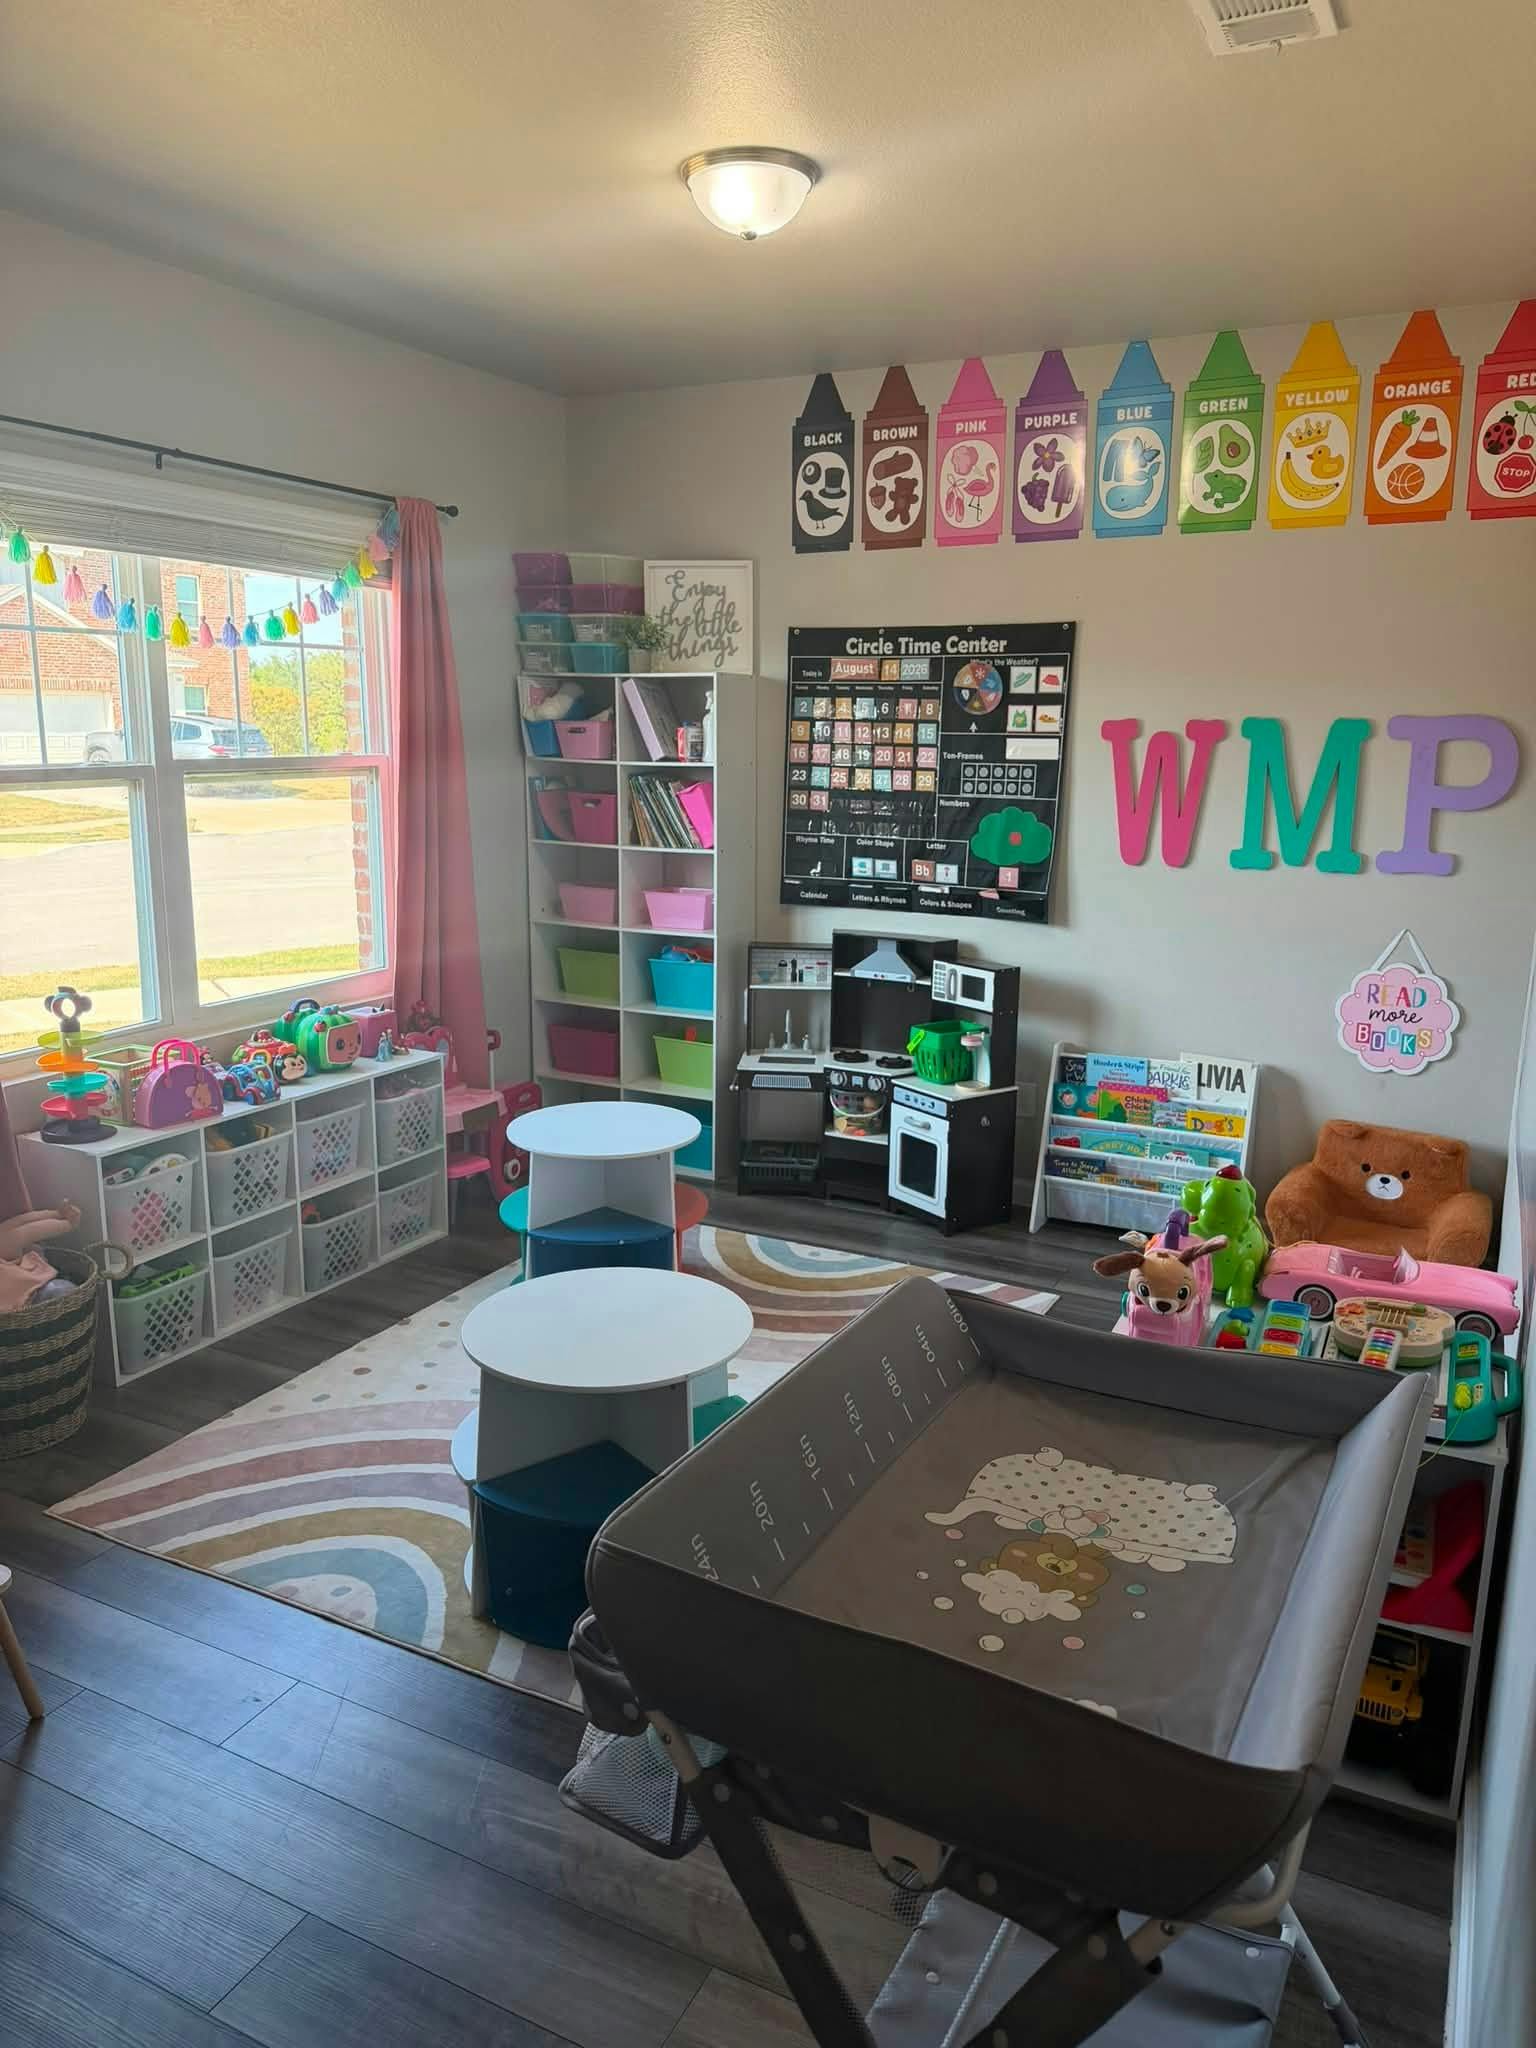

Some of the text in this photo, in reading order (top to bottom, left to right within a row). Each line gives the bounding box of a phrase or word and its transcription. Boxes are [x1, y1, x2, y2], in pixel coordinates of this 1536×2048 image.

[1285, 388, 1350, 407] YELLOW
[1383, 380, 1452, 399] ORANGE
[1116, 405, 1153, 422] BLUE
[1199, 397, 1249, 414] GREEN
[955, 419, 987, 434] PINK
[1024, 412, 1078, 430] PURPLE
[803, 432, 843, 447] BLACK
[872, 426, 918, 441] BROWN
[1502, 467, 1531, 477] STOP
[665, 570, 726, 612] Enjoy
[656, 602, 742, 638] the little
[668, 628, 738, 668] things
[845, 635, 1007, 655] Circle Time Center
[835, 662, 874, 676] August
[885, 663, 897, 676] 14
[902, 662, 929, 675] 2026
[799, 702, 808, 713] 2
[817, 702, 826, 713] 3
[839, 702, 848, 713] 4
[861, 702, 869, 713] 5
[881, 702, 889, 714] 6
[926, 703, 934, 715] 8
[796, 726, 934, 739] 9 10 11 12 13 14 15
[793, 747, 805, 758] 16
[816, 747, 828, 758] 17
[857, 750, 869, 760] 19
[876, 750, 891, 761] 20
[897, 751, 911, 762] 21
[918, 751, 934, 762] 22
[943, 752, 983, 760] Ten-Frames
[791, 770, 933, 786] 23 24 25 26 27 28 29
[791, 794, 826, 806] 30 31
[939, 799, 970, 808] Numbers
[819, 837, 835, 845] Time
[856, 838, 894, 848] Color Shape
[926, 842, 947, 850] Letter
[915, 865, 930, 876] Bb
[799, 891, 829, 900] Calendar
[919, 898, 939, 907] Colors
[947, 901, 972, 909] Shapes
[1367, 983, 1427, 1008] READ
[1368, 1008, 1423, 1024] more
[1356, 1023, 1433, 1055] BOOKS
[946, 1297, 969, 1333] 00in
[915, 1323, 936, 1362] 04in
[881, 1356, 903, 1397] 08in
[844, 1392, 864, 1436] 12in
[800, 1434, 824, 1481] 16in
[750, 1480, 774, 1532] 20in
[691, 1533, 719, 1581] 24in
